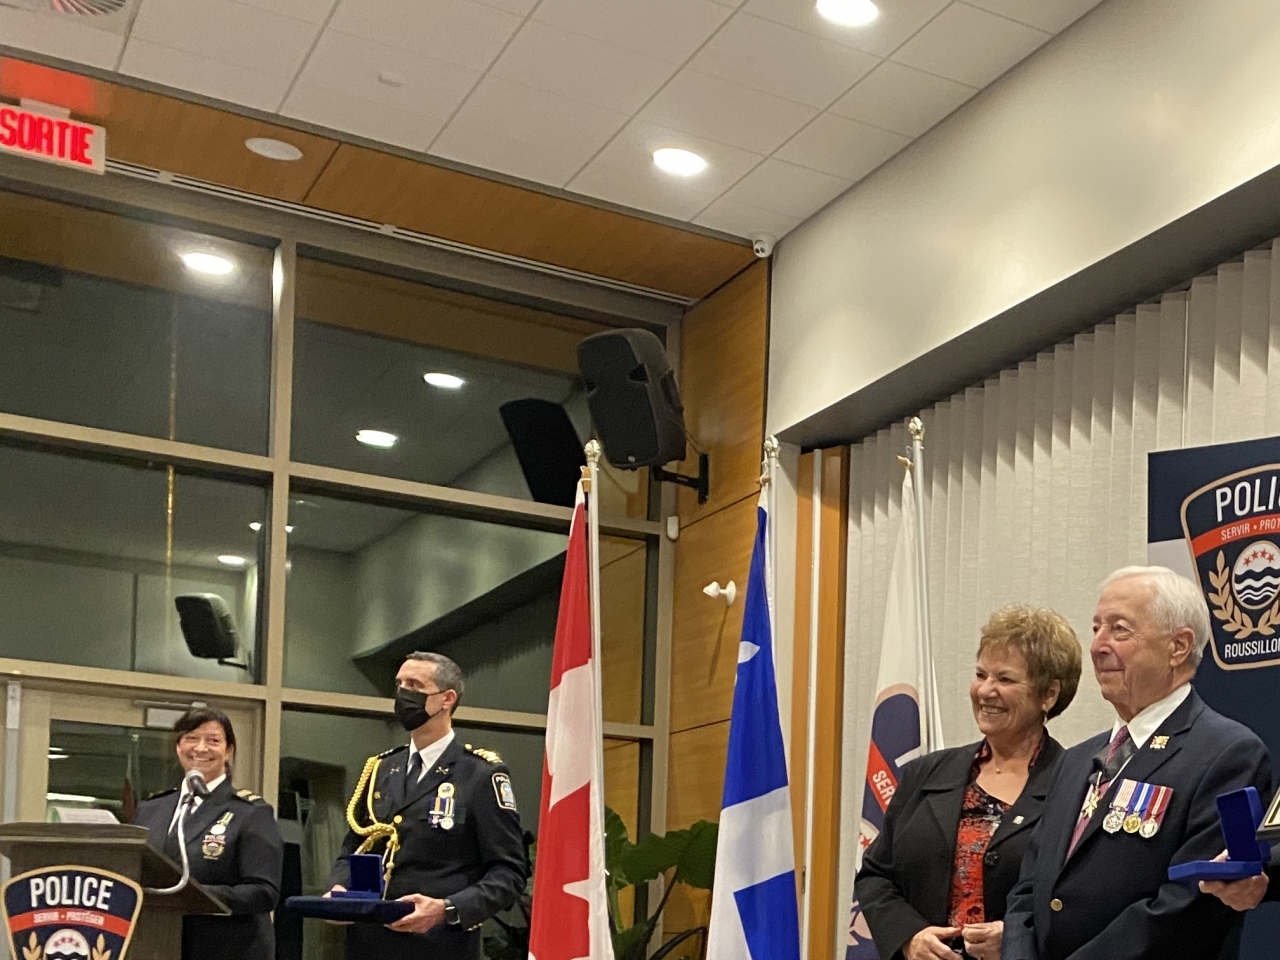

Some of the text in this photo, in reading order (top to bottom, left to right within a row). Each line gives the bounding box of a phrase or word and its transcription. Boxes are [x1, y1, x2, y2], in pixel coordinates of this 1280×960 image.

[0, 108, 94, 165] SORTIE
[1221, 523, 1250, 541] SERVIR
[872, 769, 897, 806] SER
[29, 875, 115, 911] POLICE
